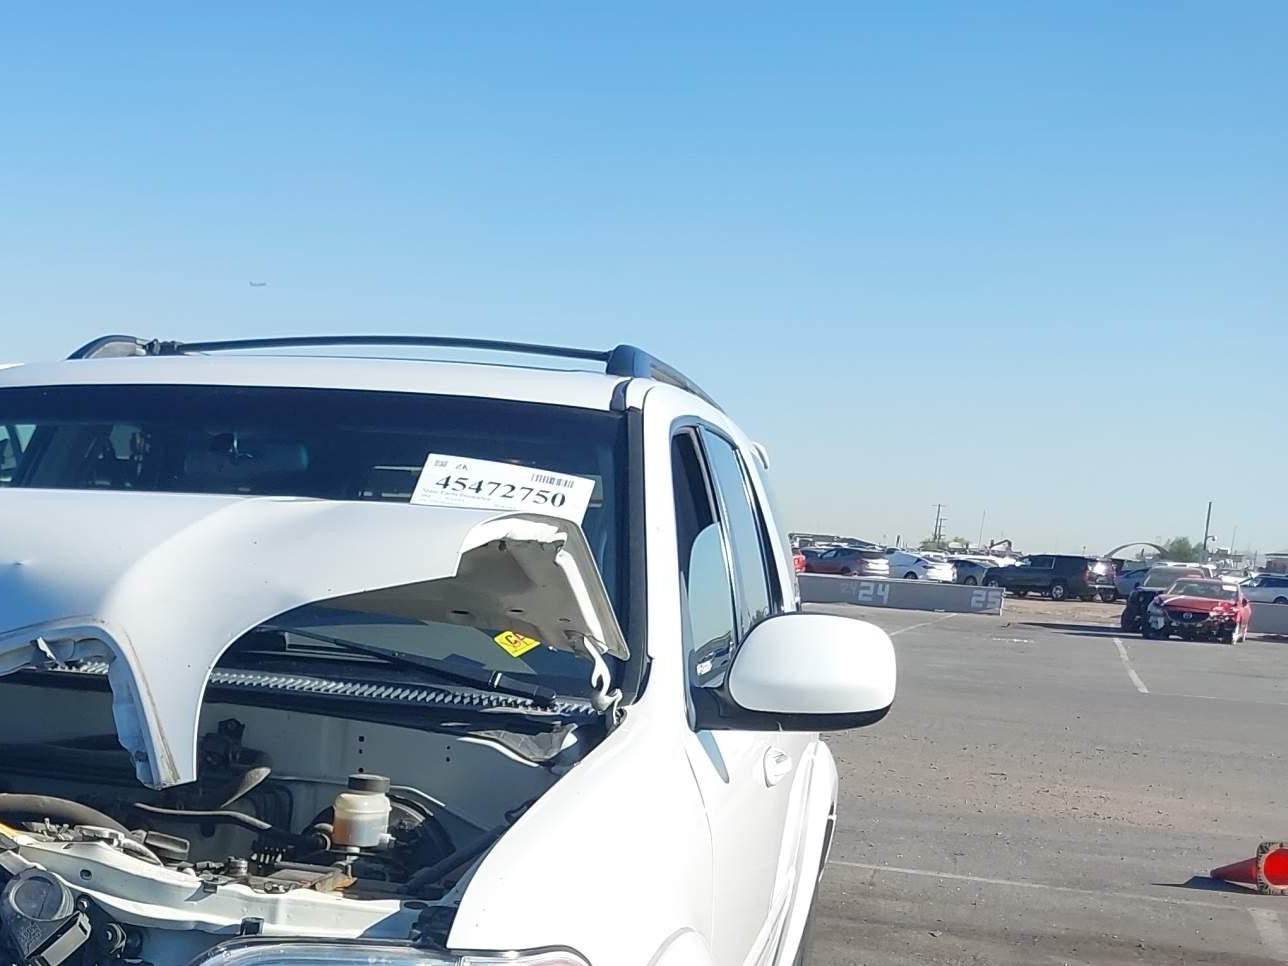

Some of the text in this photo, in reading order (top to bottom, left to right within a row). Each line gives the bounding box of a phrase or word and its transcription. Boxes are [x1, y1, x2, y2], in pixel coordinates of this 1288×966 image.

[435, 475, 567, 508] 45472750
[858, 582, 890, 604] 24
[970, 590, 1001, 608] 25
